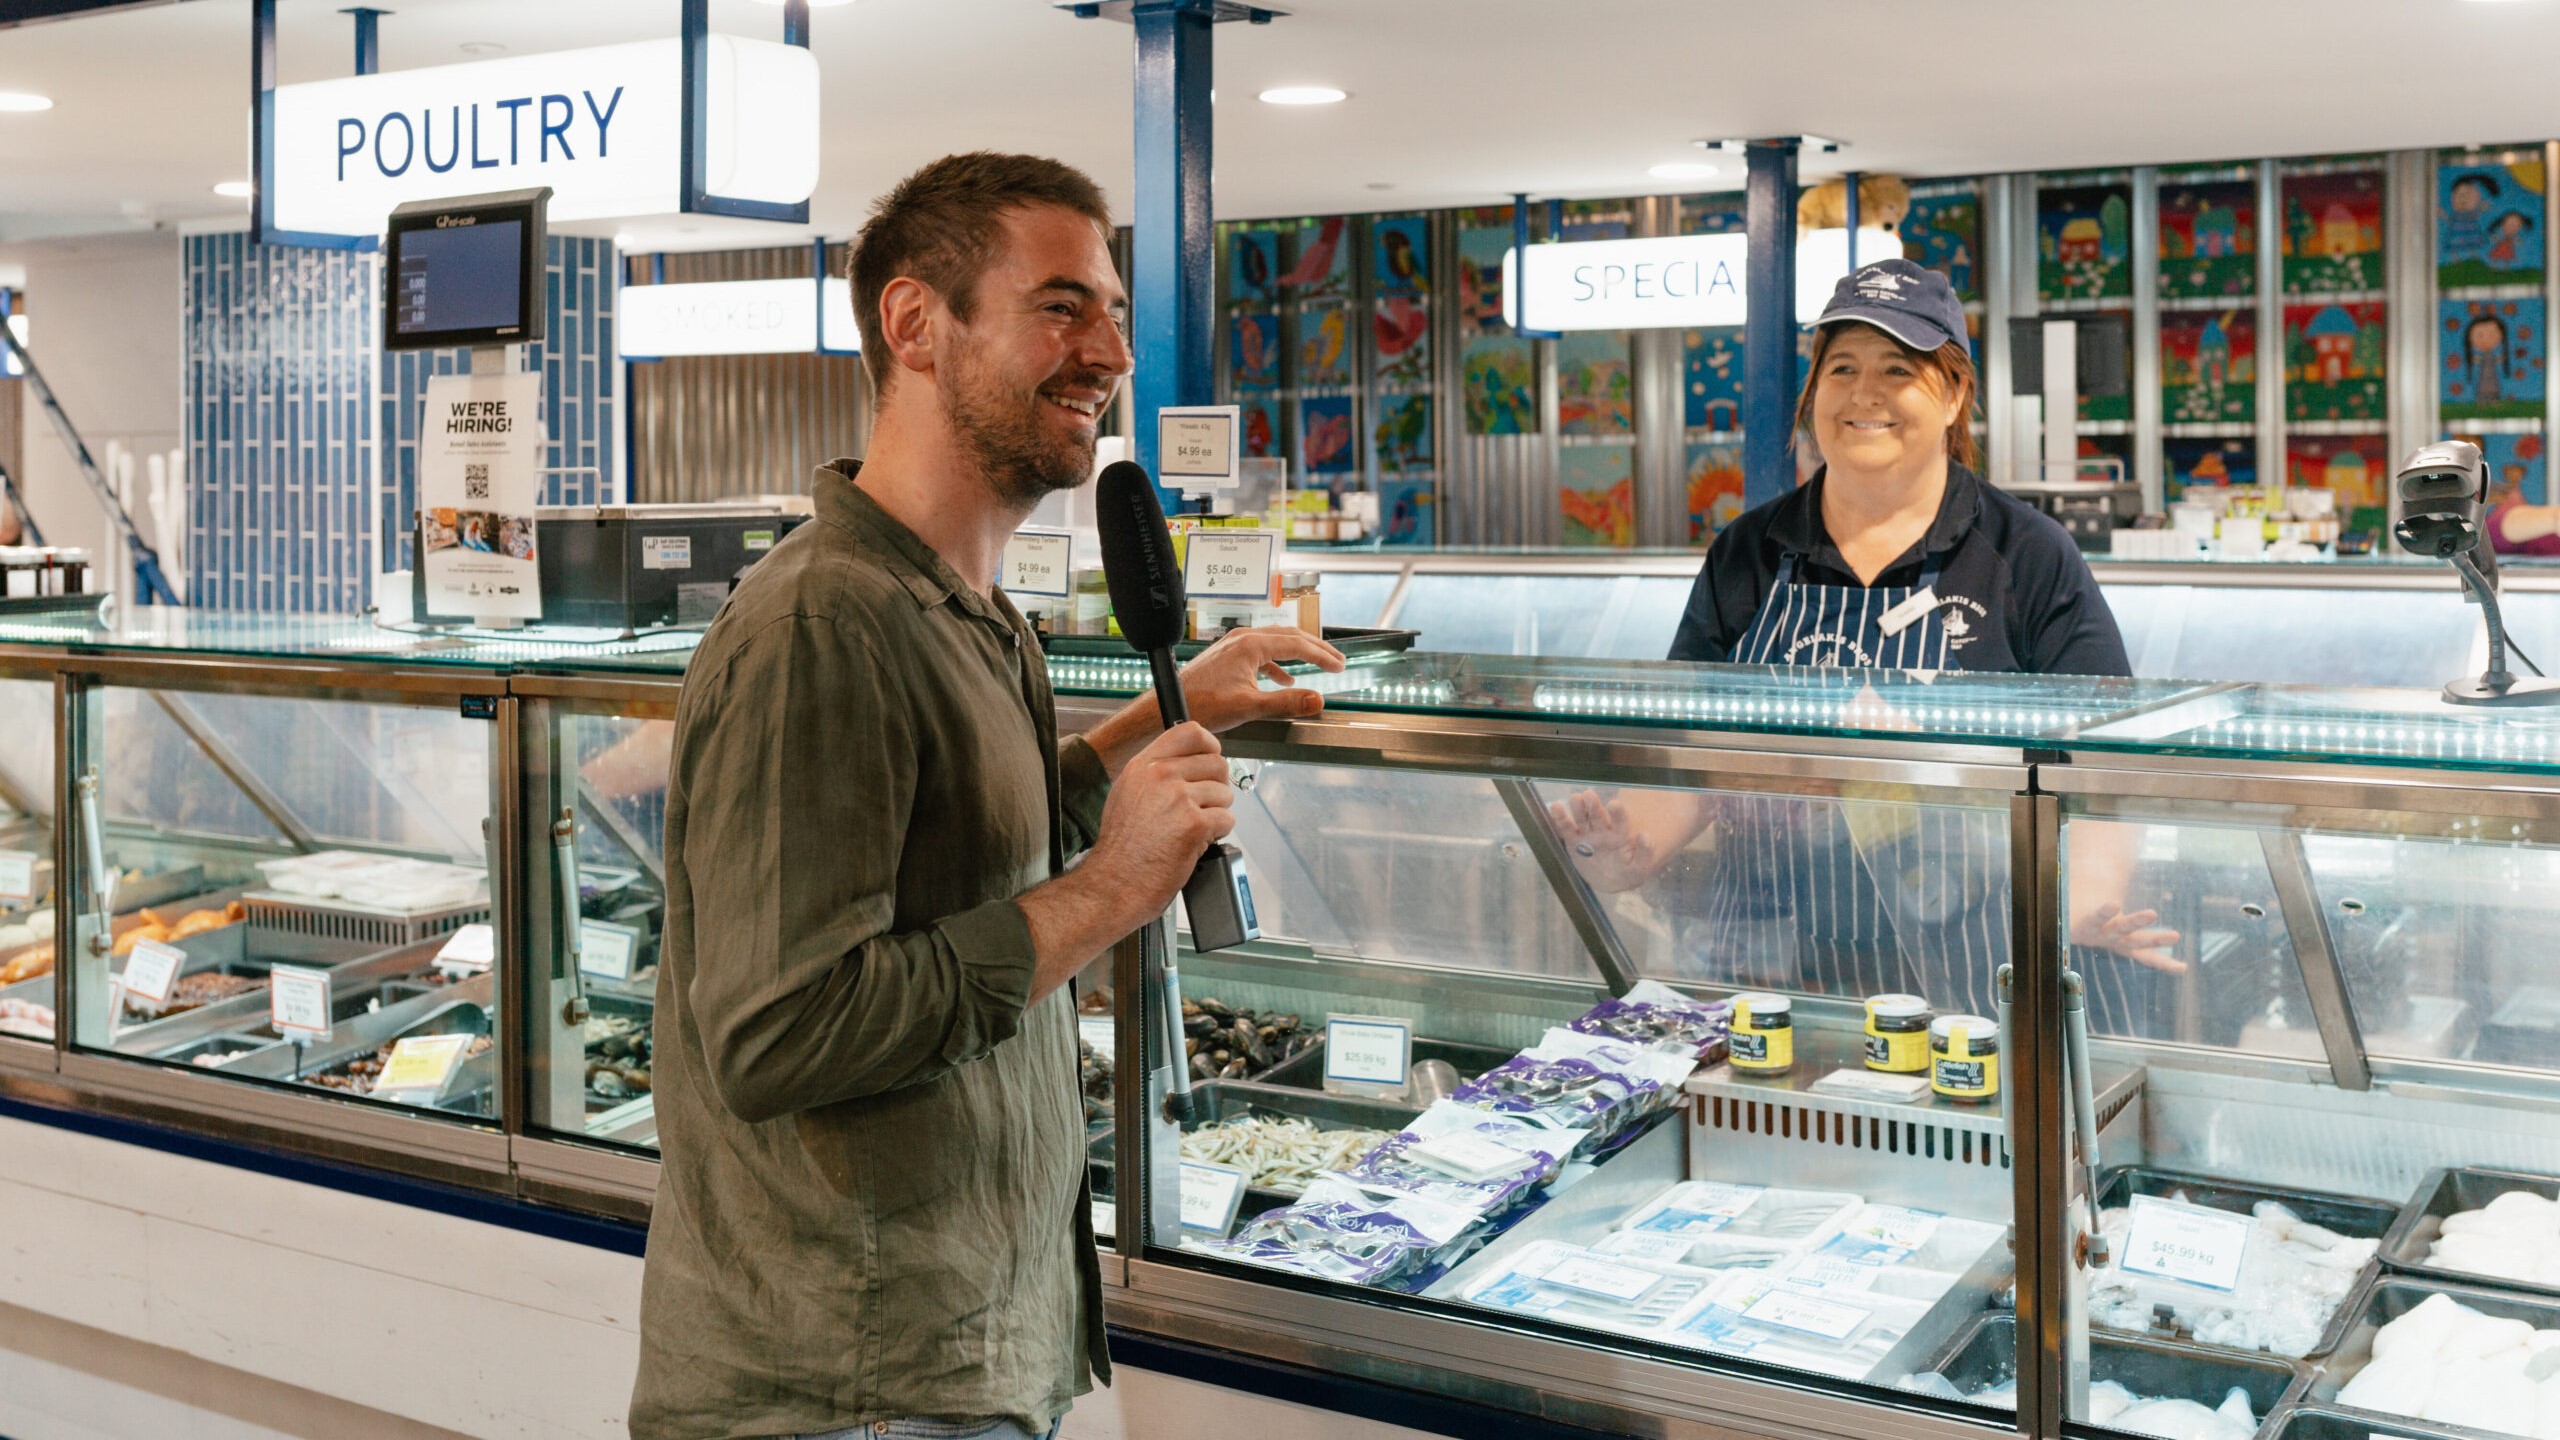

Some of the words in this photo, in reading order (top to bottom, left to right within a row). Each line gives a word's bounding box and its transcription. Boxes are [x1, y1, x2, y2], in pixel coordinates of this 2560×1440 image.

[338, 86, 624, 181] POULTRY
[1574, 260, 1738, 302] SPECIA
[655, 300, 785, 333] SMOKED
[451, 401, 507, 417] WE'RE
[446, 417, 512, 434] HIRING!
[1178, 446, 1200, 456] $4.99
[1202, 449, 1212, 457] ea
[1130, 494, 1161, 580] SENNHEISER
[1219, 544, 1239, 552] Sauce
[1017, 562, 1039, 574] $4.99
[1041, 566, 1051, 574] ea
[1206, 565, 1233, 575] $5.40
[1235, 567, 1247, 575] ea
[1344, 1052, 1374, 1063] $25.99
[1376, 1054, 1387, 1066] kg
[2152, 1241, 2196, 1259] $45.99
[2198, 1251, 2215, 1265] kg
